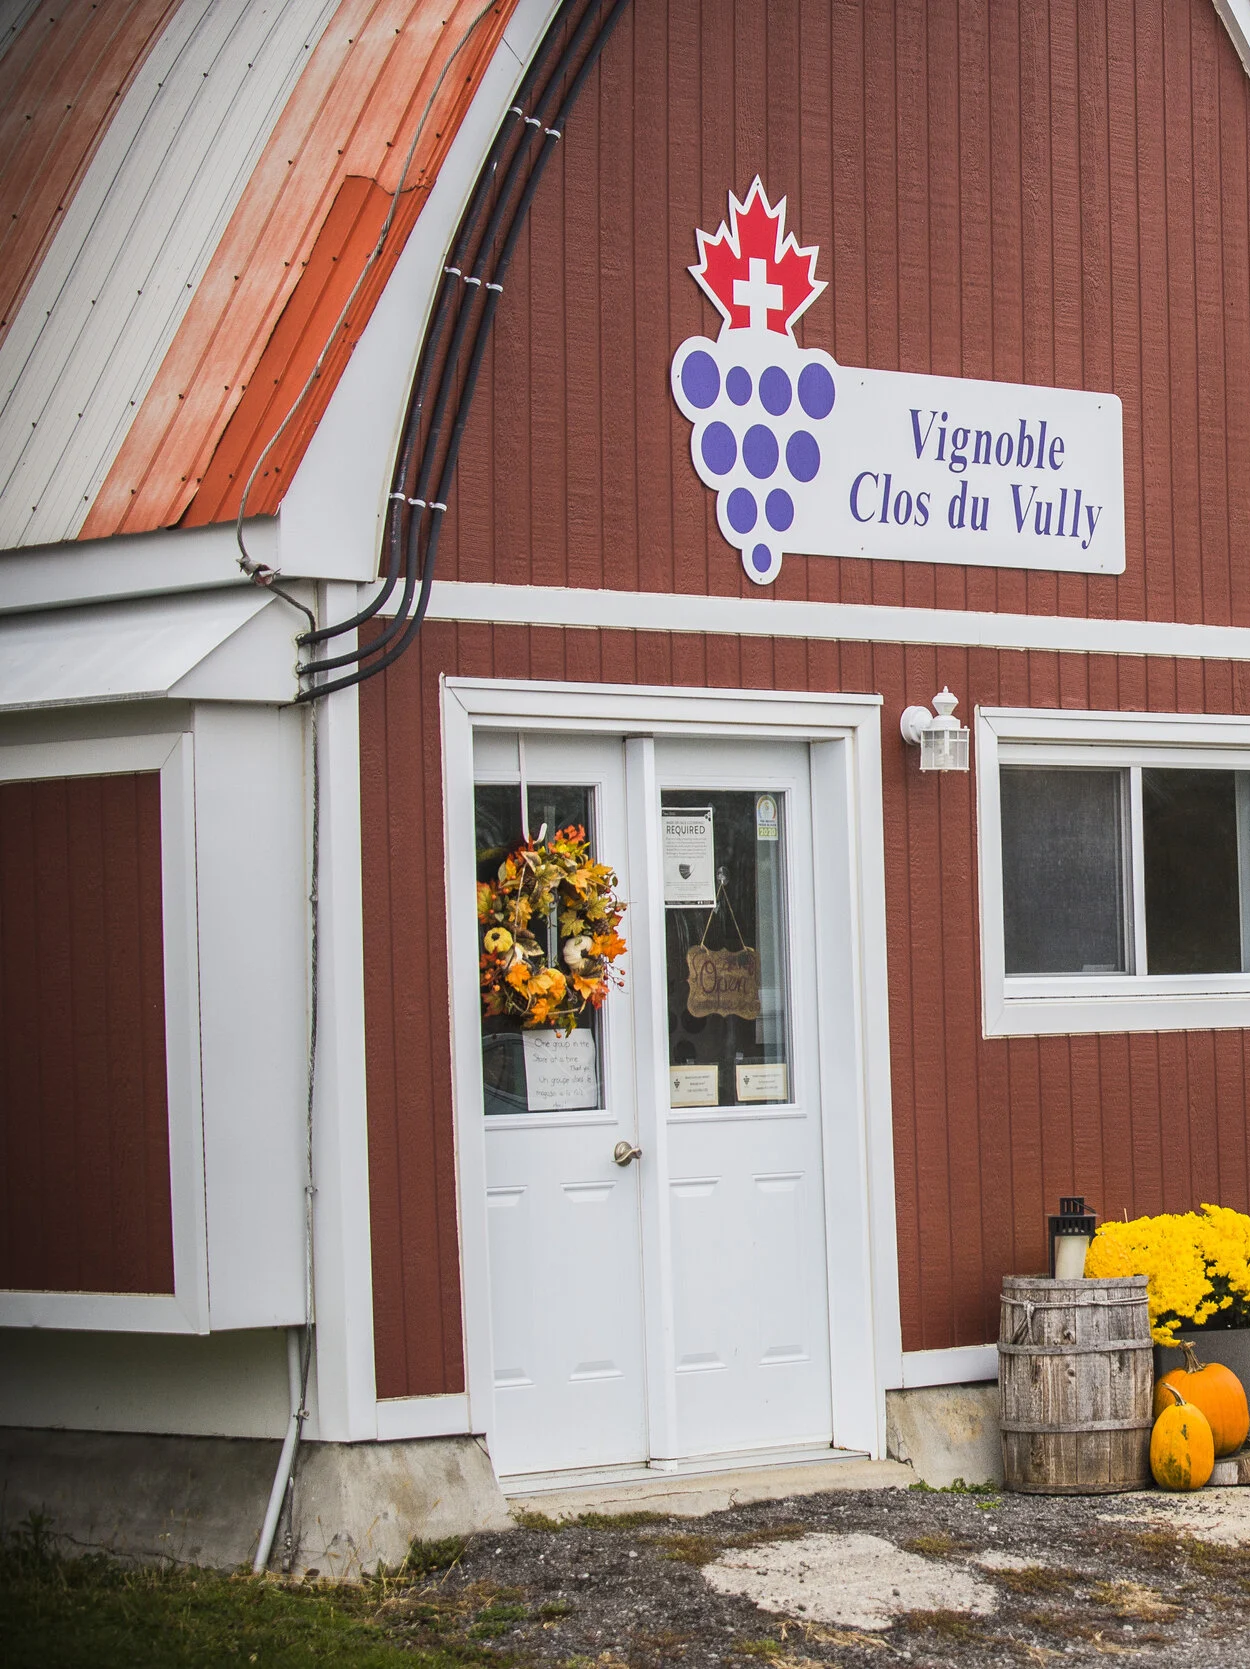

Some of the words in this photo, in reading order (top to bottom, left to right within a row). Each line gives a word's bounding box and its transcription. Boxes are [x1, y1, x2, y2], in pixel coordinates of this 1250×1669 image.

[909, 408, 1065, 473] Vignoble
[849, 471, 931, 527] Clos
[948, 479, 990, 532] du
[1010, 483, 1103, 550] Vully
[666, 825, 706, 836] REQUIRED
[759, 827, 776, 836] 2020
[700, 960, 748, 1007] Open
[534, 1037, 551, 1048] One
